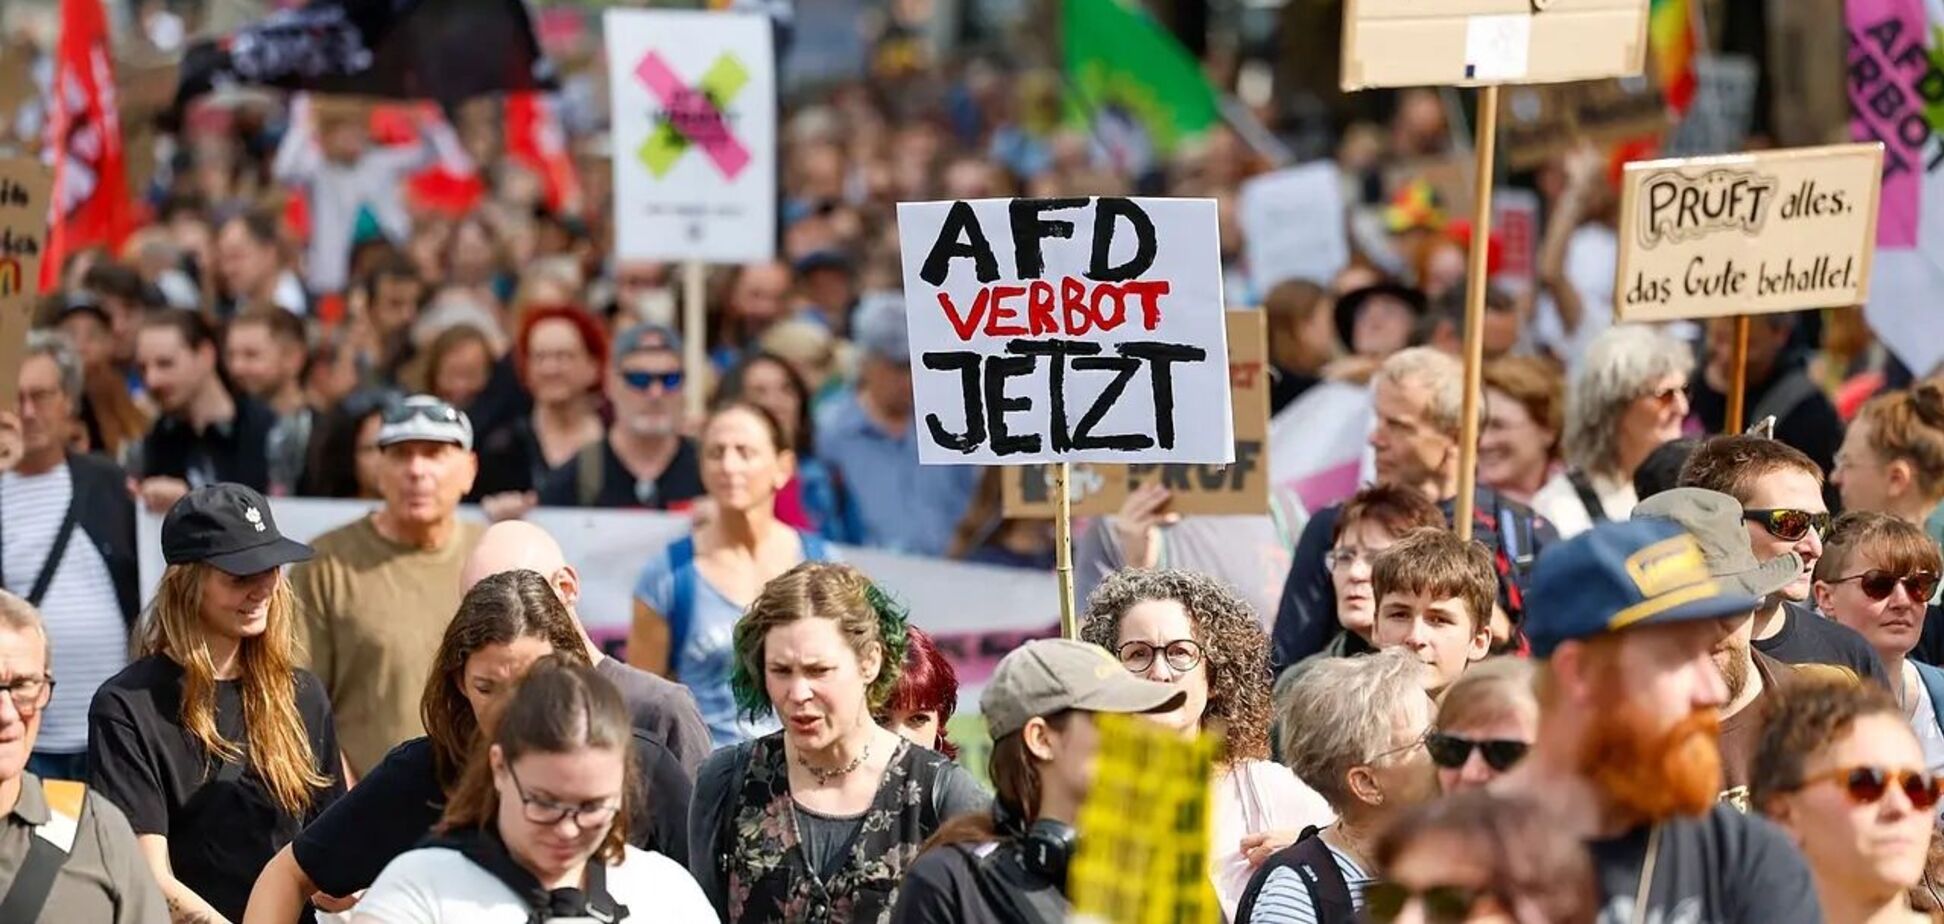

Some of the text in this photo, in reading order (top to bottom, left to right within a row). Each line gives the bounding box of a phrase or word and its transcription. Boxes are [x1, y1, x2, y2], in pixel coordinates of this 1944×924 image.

[920, 197, 1157, 286] AFD
[937, 276, 1170, 341] VERBOT
[1626, 271, 1671, 305] das
[1684, 256, 1747, 297] Gute
[922, 338, 1206, 456] JETZT
